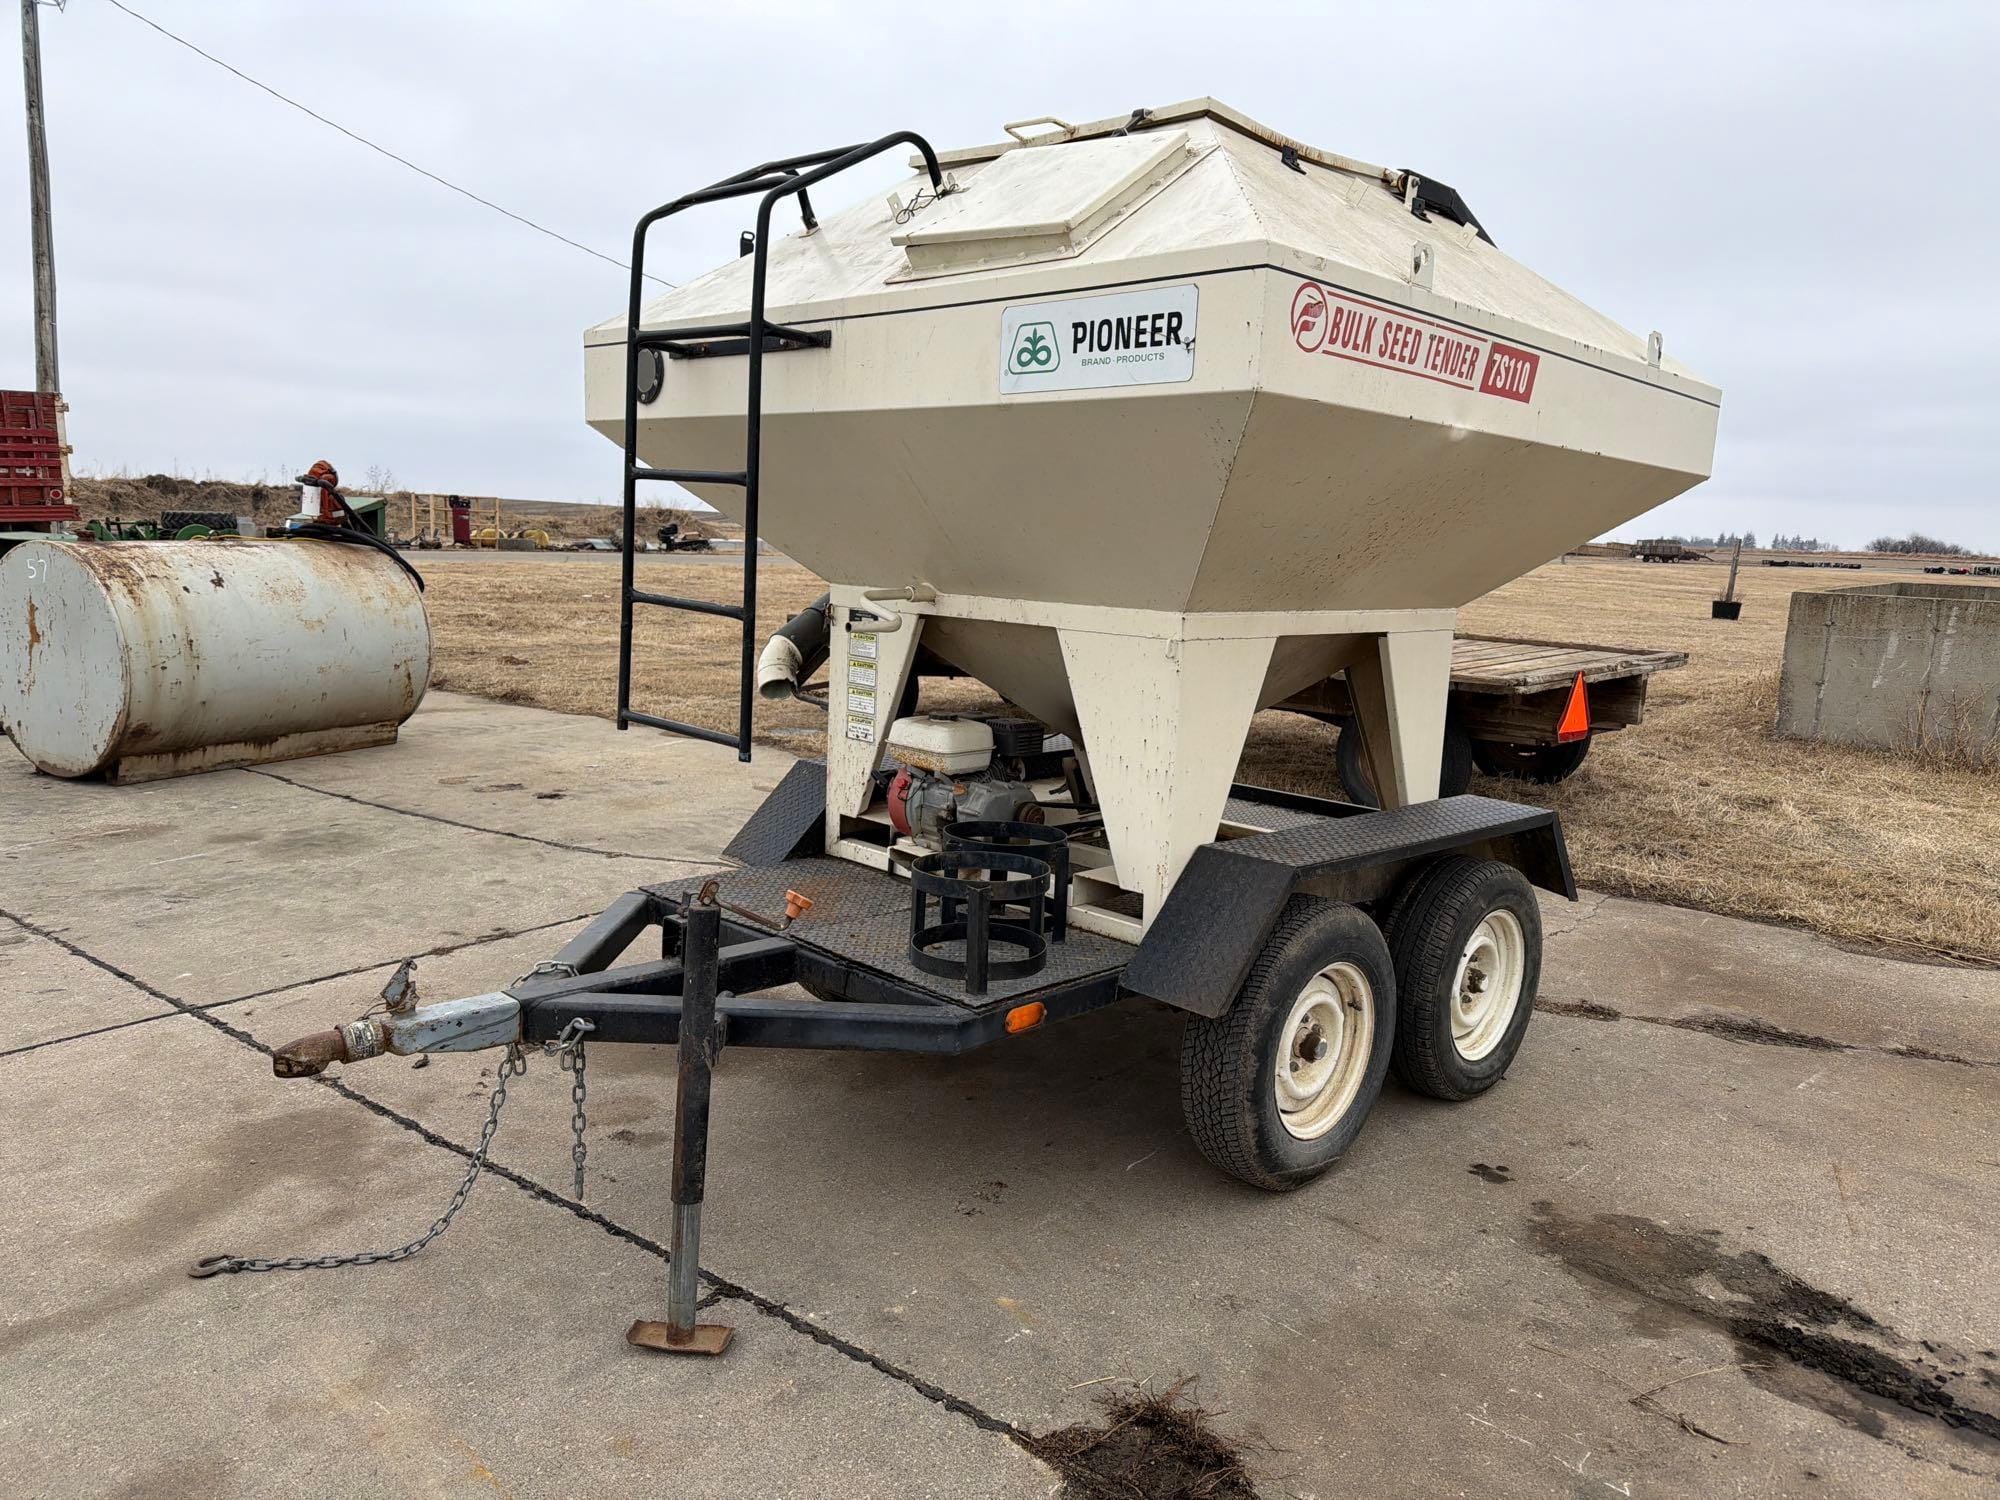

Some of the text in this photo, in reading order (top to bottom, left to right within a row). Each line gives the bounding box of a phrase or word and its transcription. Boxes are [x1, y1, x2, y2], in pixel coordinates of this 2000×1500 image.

[1071, 310, 1183, 354] PIONEER
[1081, 352, 1165, 367] BRAND PRODUCTS
[1328, 305, 1531, 394] BULK SEED TENDER 7S110
[26, 558, 47, 583] 57
